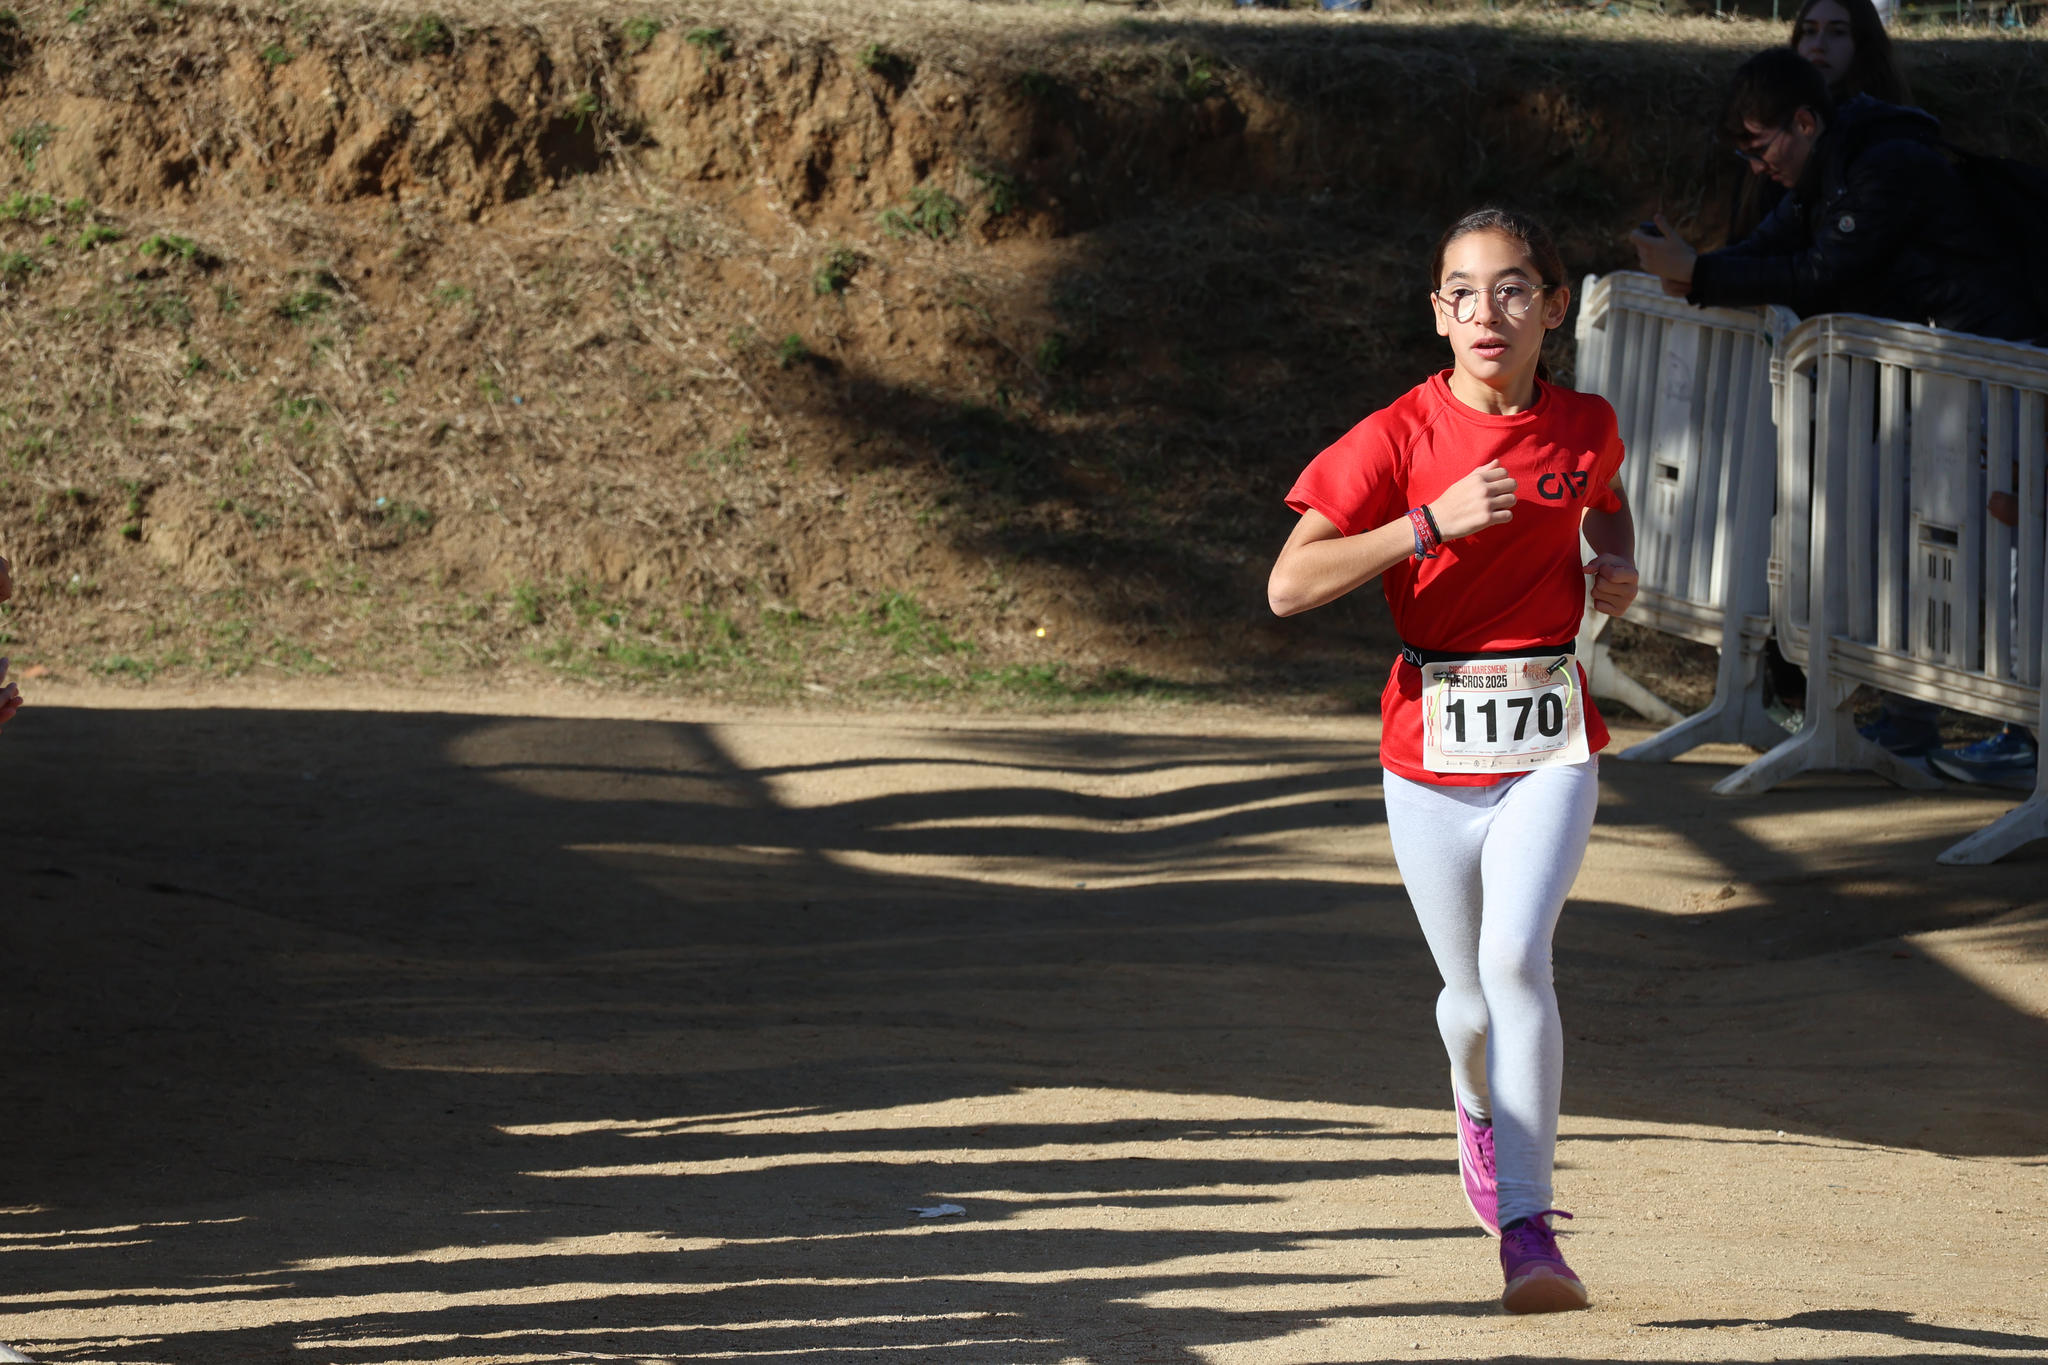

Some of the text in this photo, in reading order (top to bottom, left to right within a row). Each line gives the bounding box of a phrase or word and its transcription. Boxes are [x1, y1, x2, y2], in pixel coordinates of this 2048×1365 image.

[1402, 646, 1422, 667] ON
[1448, 665, 1471, 674] CIRCUIT
[1462, 675, 1484, 688] CROS
[1485, 675, 1508, 688] 2025
[1446, 692, 1563, 742] 1170
